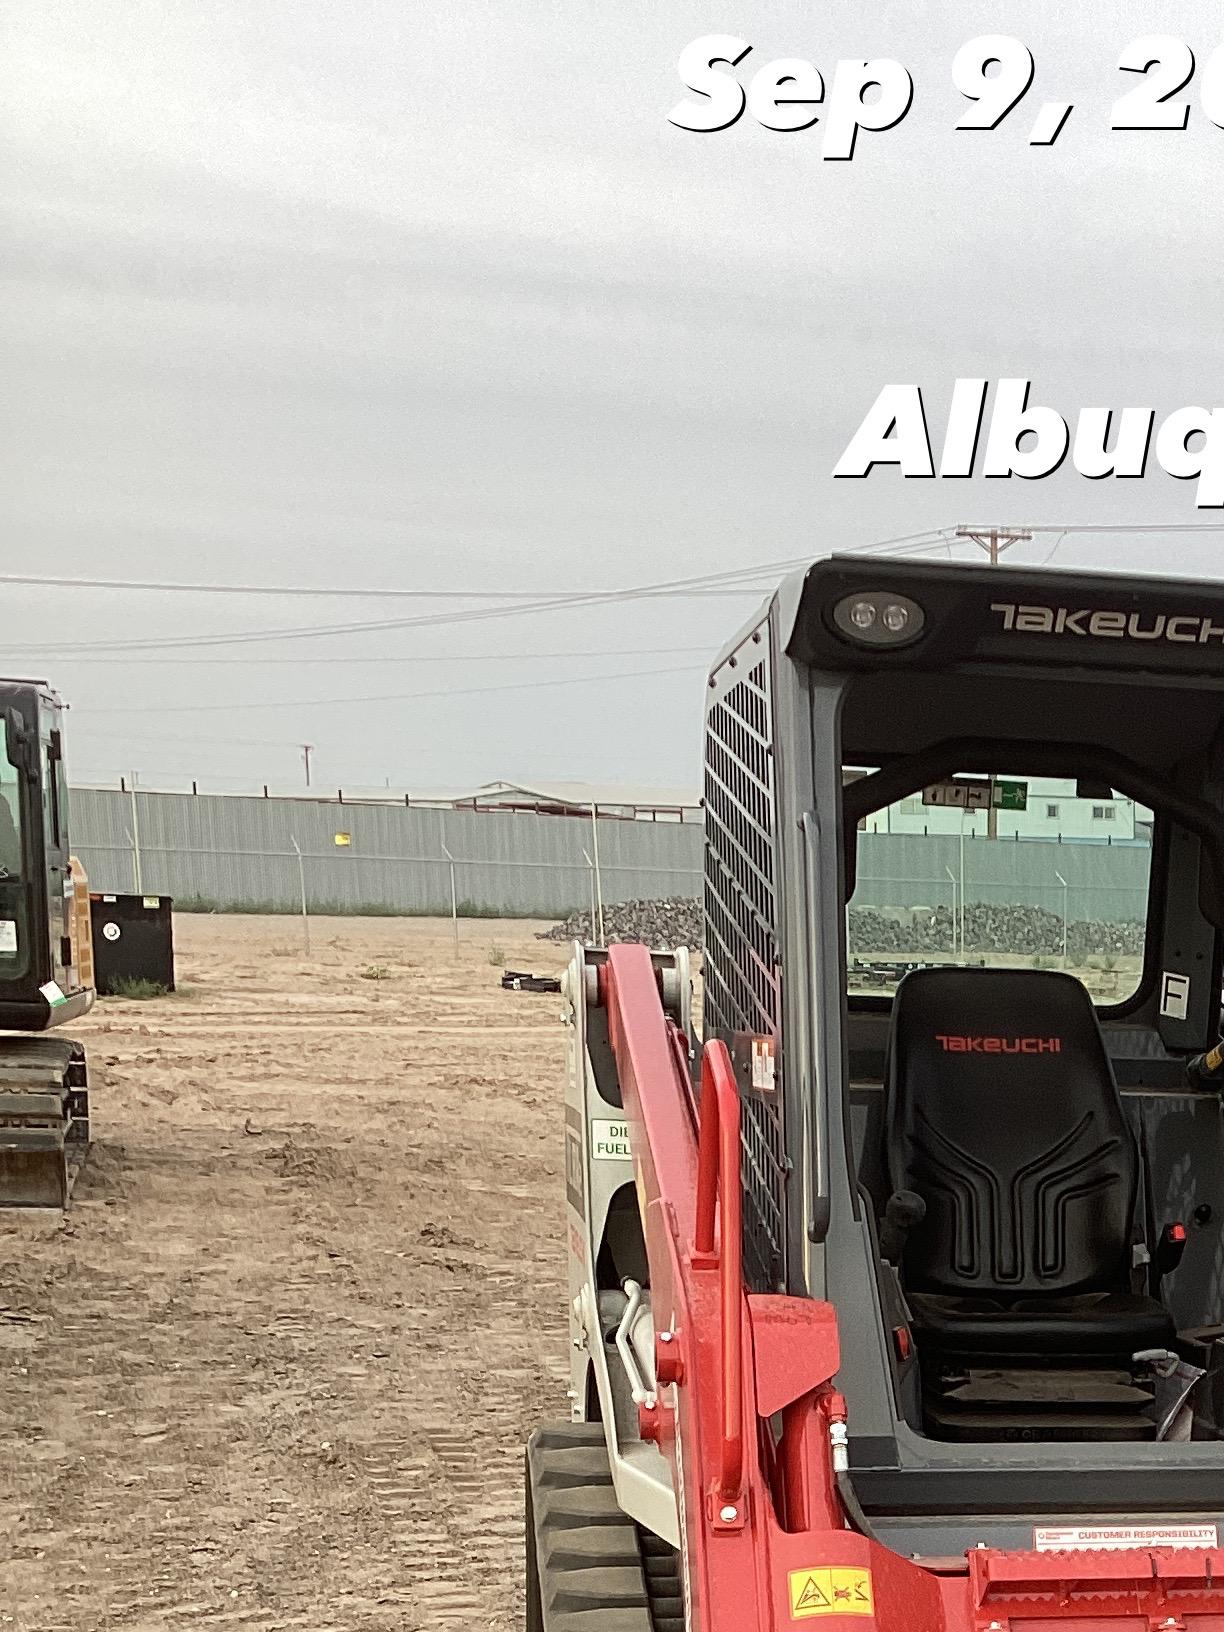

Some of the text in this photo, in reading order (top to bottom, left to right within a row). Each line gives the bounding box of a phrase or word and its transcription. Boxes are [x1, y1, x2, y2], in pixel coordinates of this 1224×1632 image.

[597, 1142, 632, 1155] FUEL
[1078, 1530, 1131, 1540] CUSTOMER
[1133, 1529, 1215, 1539] RESPONSIBILITY
